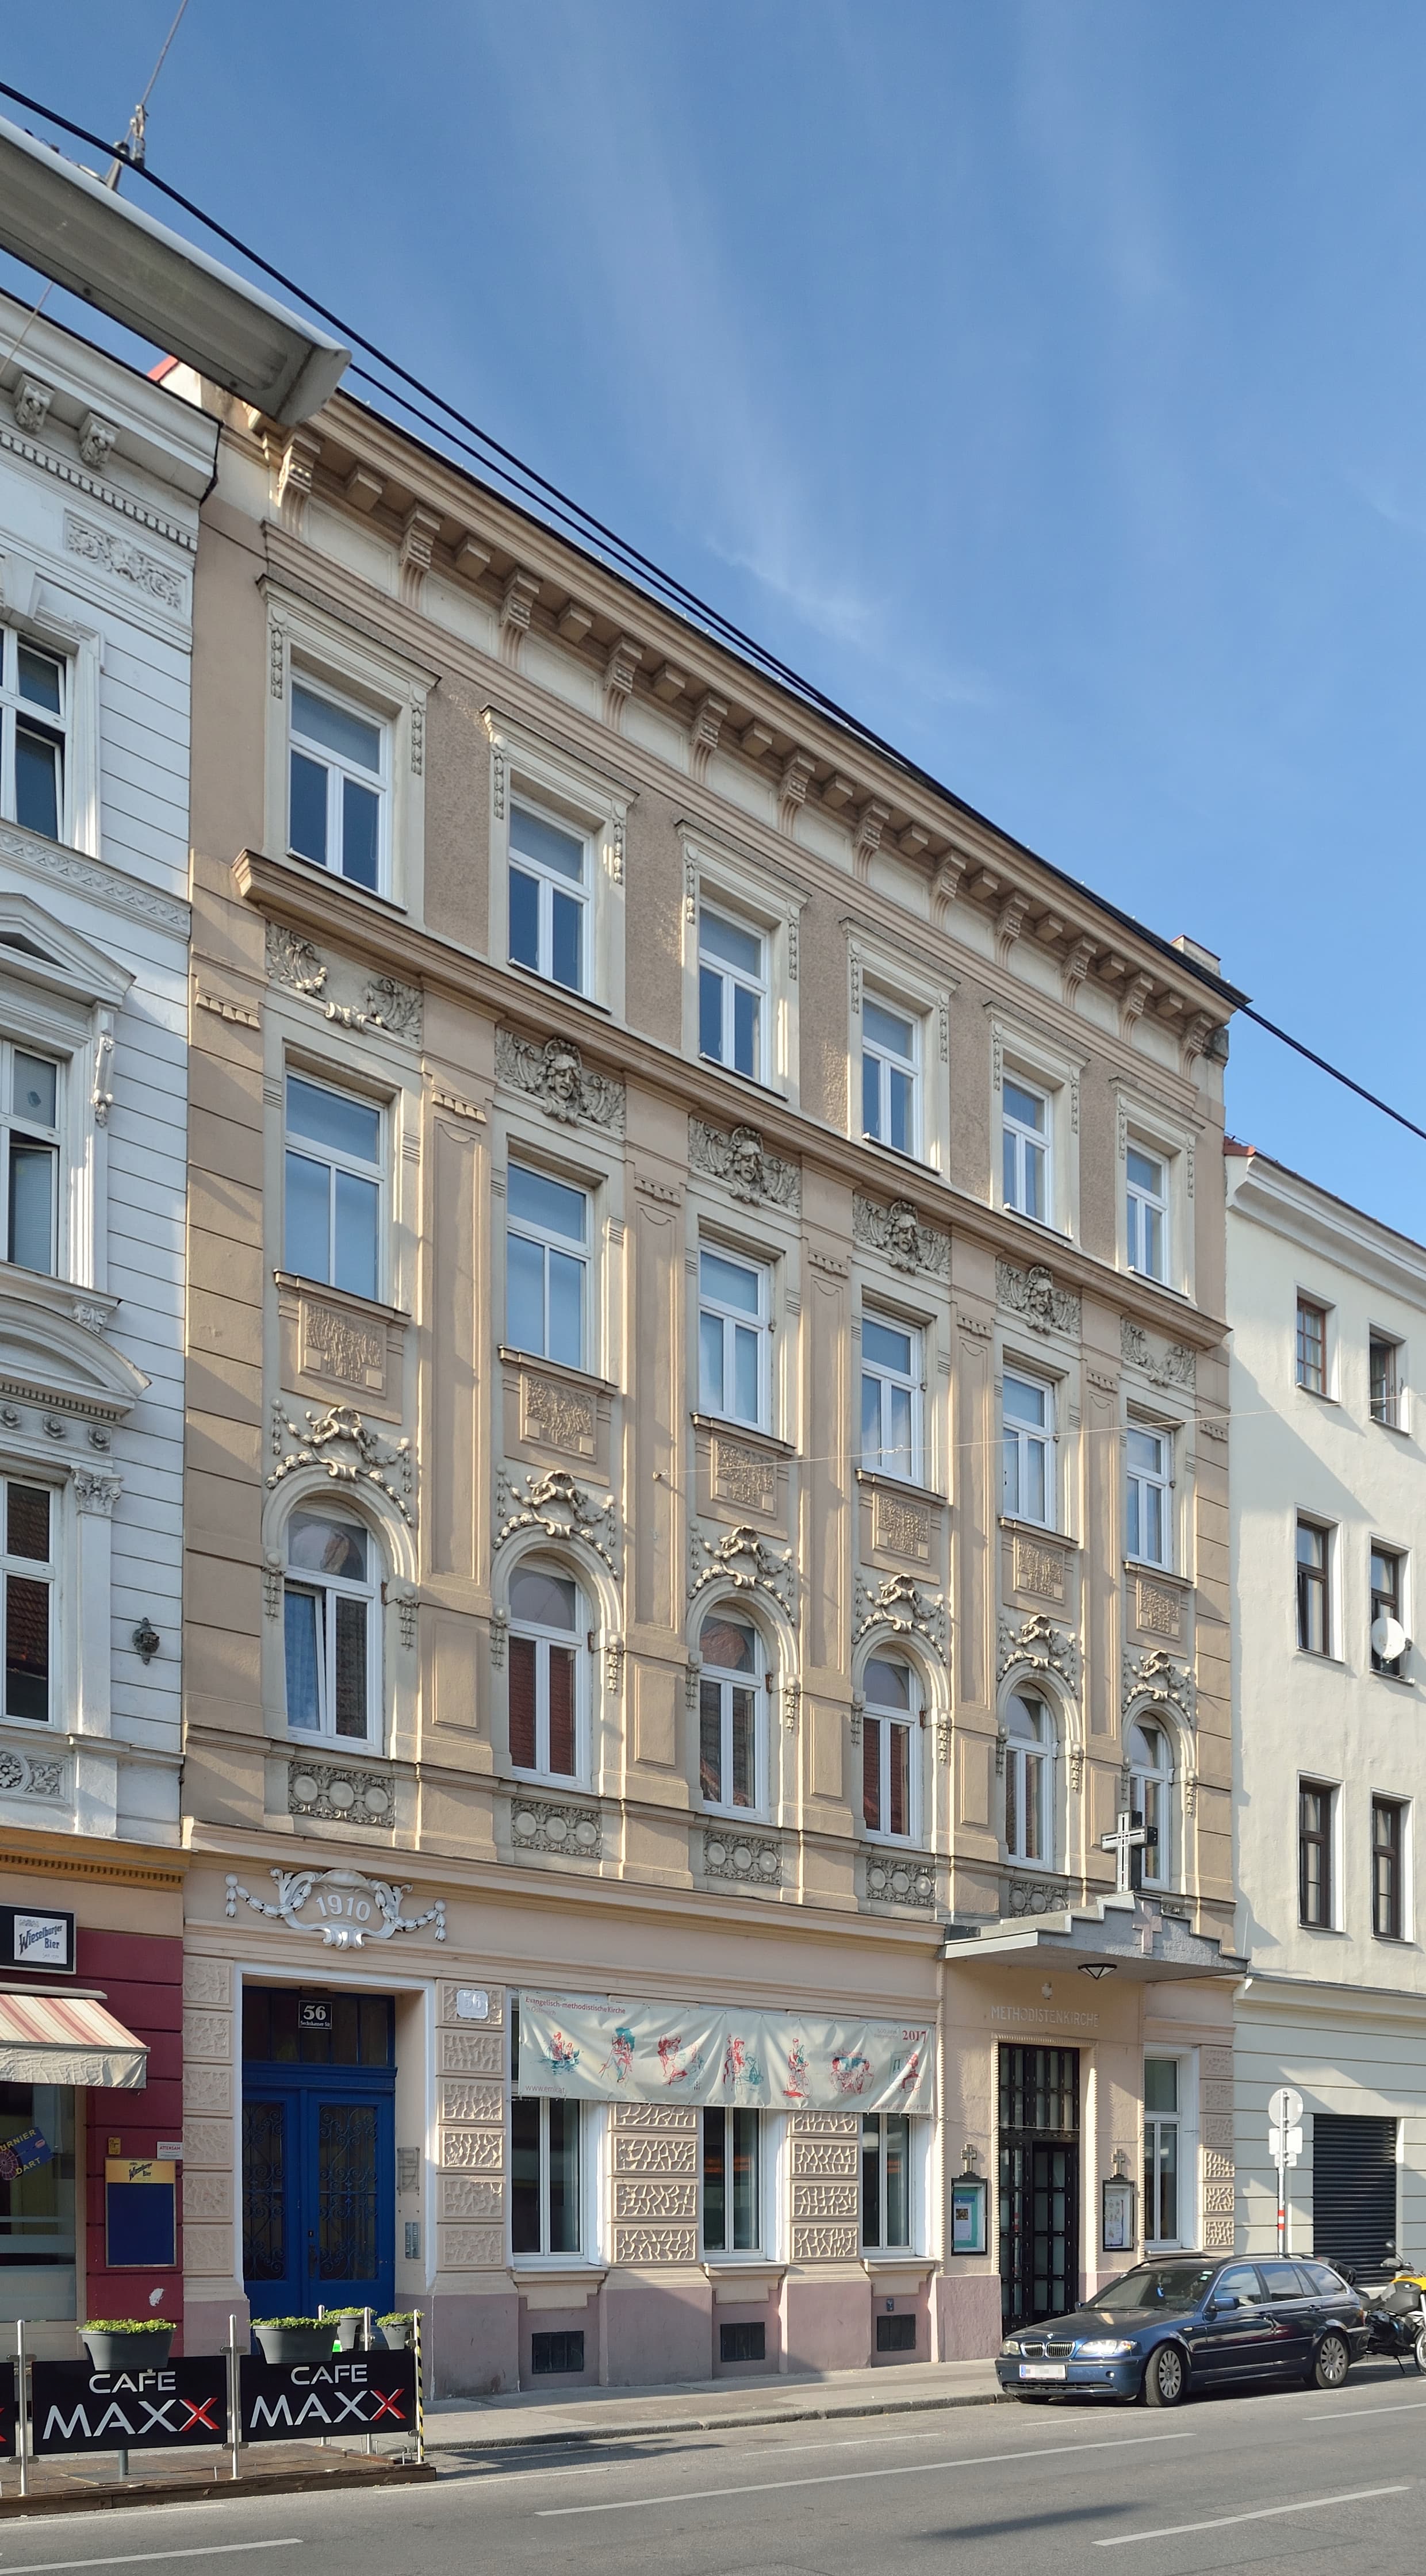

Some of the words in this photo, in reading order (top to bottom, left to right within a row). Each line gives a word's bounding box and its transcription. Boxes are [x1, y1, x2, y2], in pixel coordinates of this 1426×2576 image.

[316, 1895, 370, 1922] 1910
[19, 1925, 63, 1956] Wieselburger
[44, 1938, 59, 1949] Bier
[463, 1992, 484, 2010] 56
[526, 1996, 607, 2012] Evangelisch-methodistische
[607, 2006, 626, 2014] Kirche
[303, 2005, 326, 2021] 56
[991, 2005, 1100, 2027] METHODISTENKIRCHE
[902, 2030, 927, 2044] 2017
[0, 2129, 36, 2151] URNIER
[16, 2157, 40, 2175] DART
[89, 2371, 176, 2394] CAFE
[291, 2364, 368, 2385] CAFE
[43, 2397, 221, 2440] MAXX
[250, 2388, 406, 2428] MAXX
